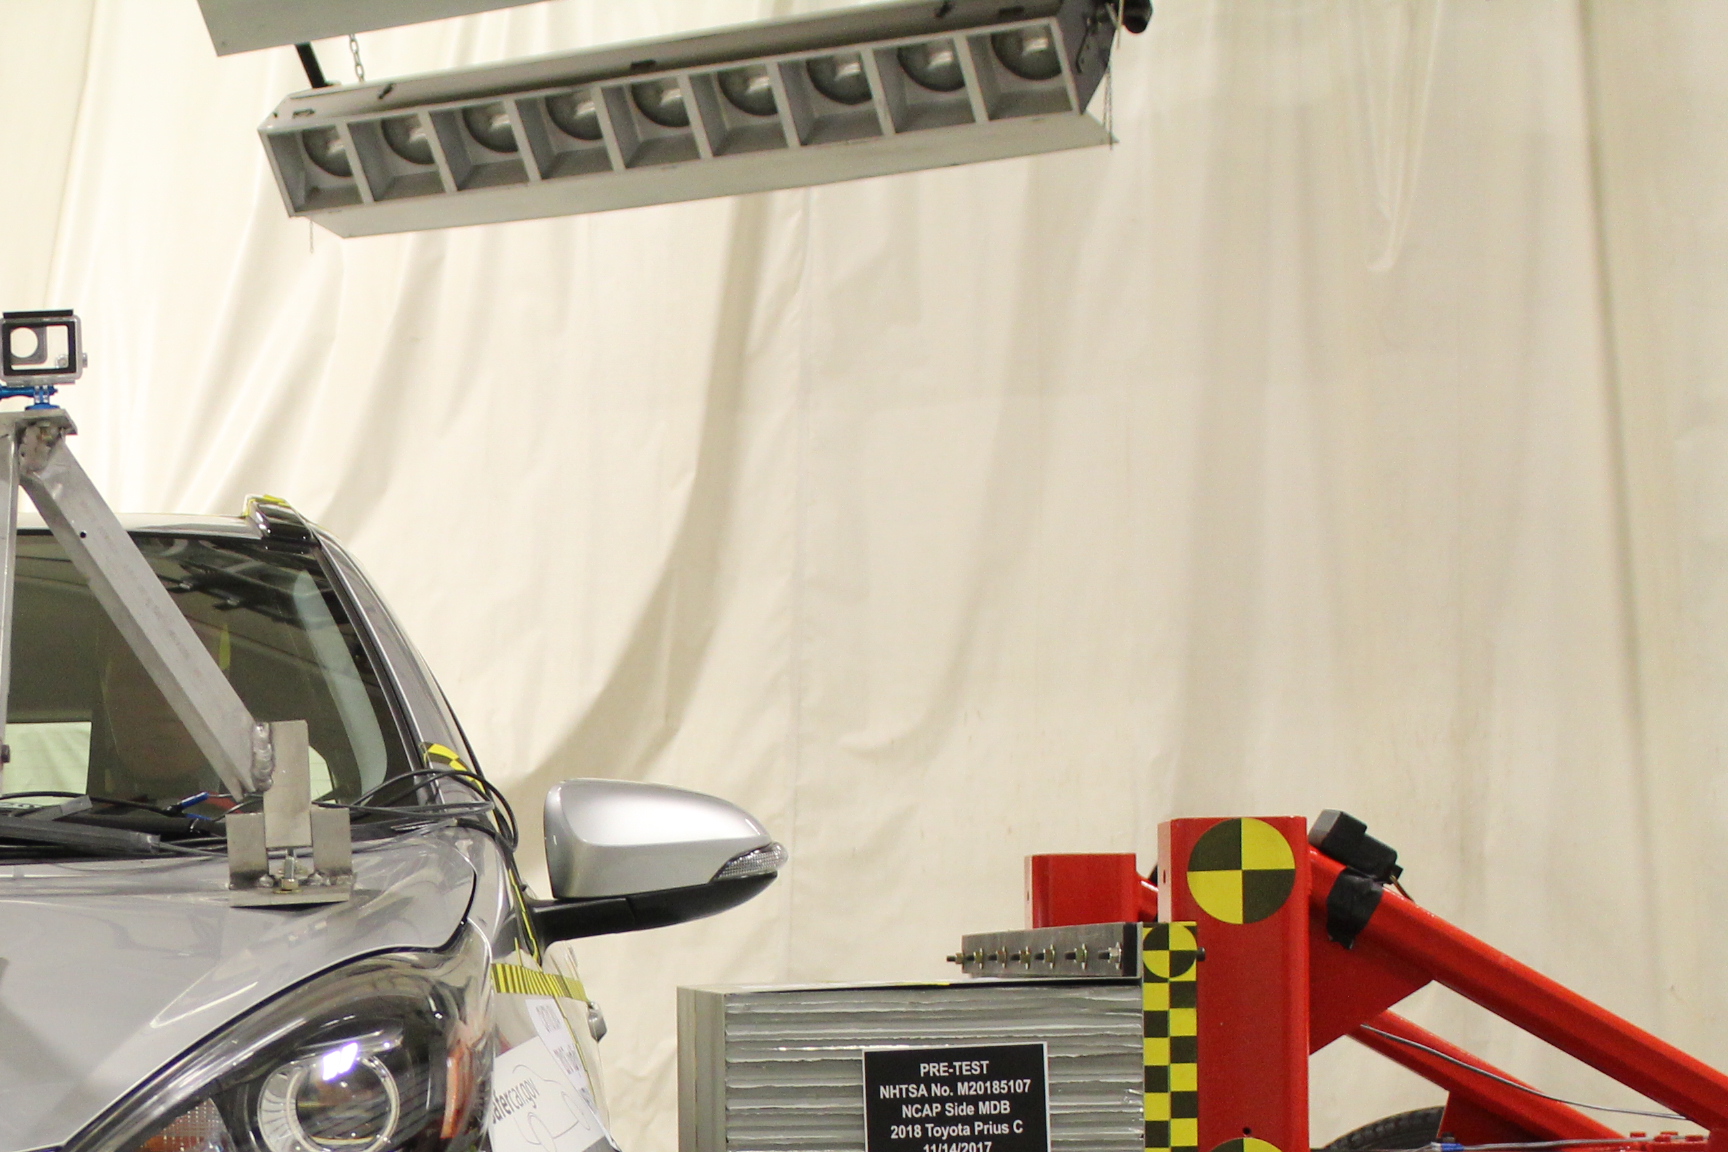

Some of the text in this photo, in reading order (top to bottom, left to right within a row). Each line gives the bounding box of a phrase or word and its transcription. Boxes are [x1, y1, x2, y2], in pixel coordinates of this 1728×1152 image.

[920, 1061, 989, 1076] PRE-TEST
[880, 1079, 1030, 1098] NHTSA No. M20185107
[902, 1101, 1010, 1118] NCAP Side MDB
[891, 1120, 1023, 1139] 2018 Toyota Prius C
